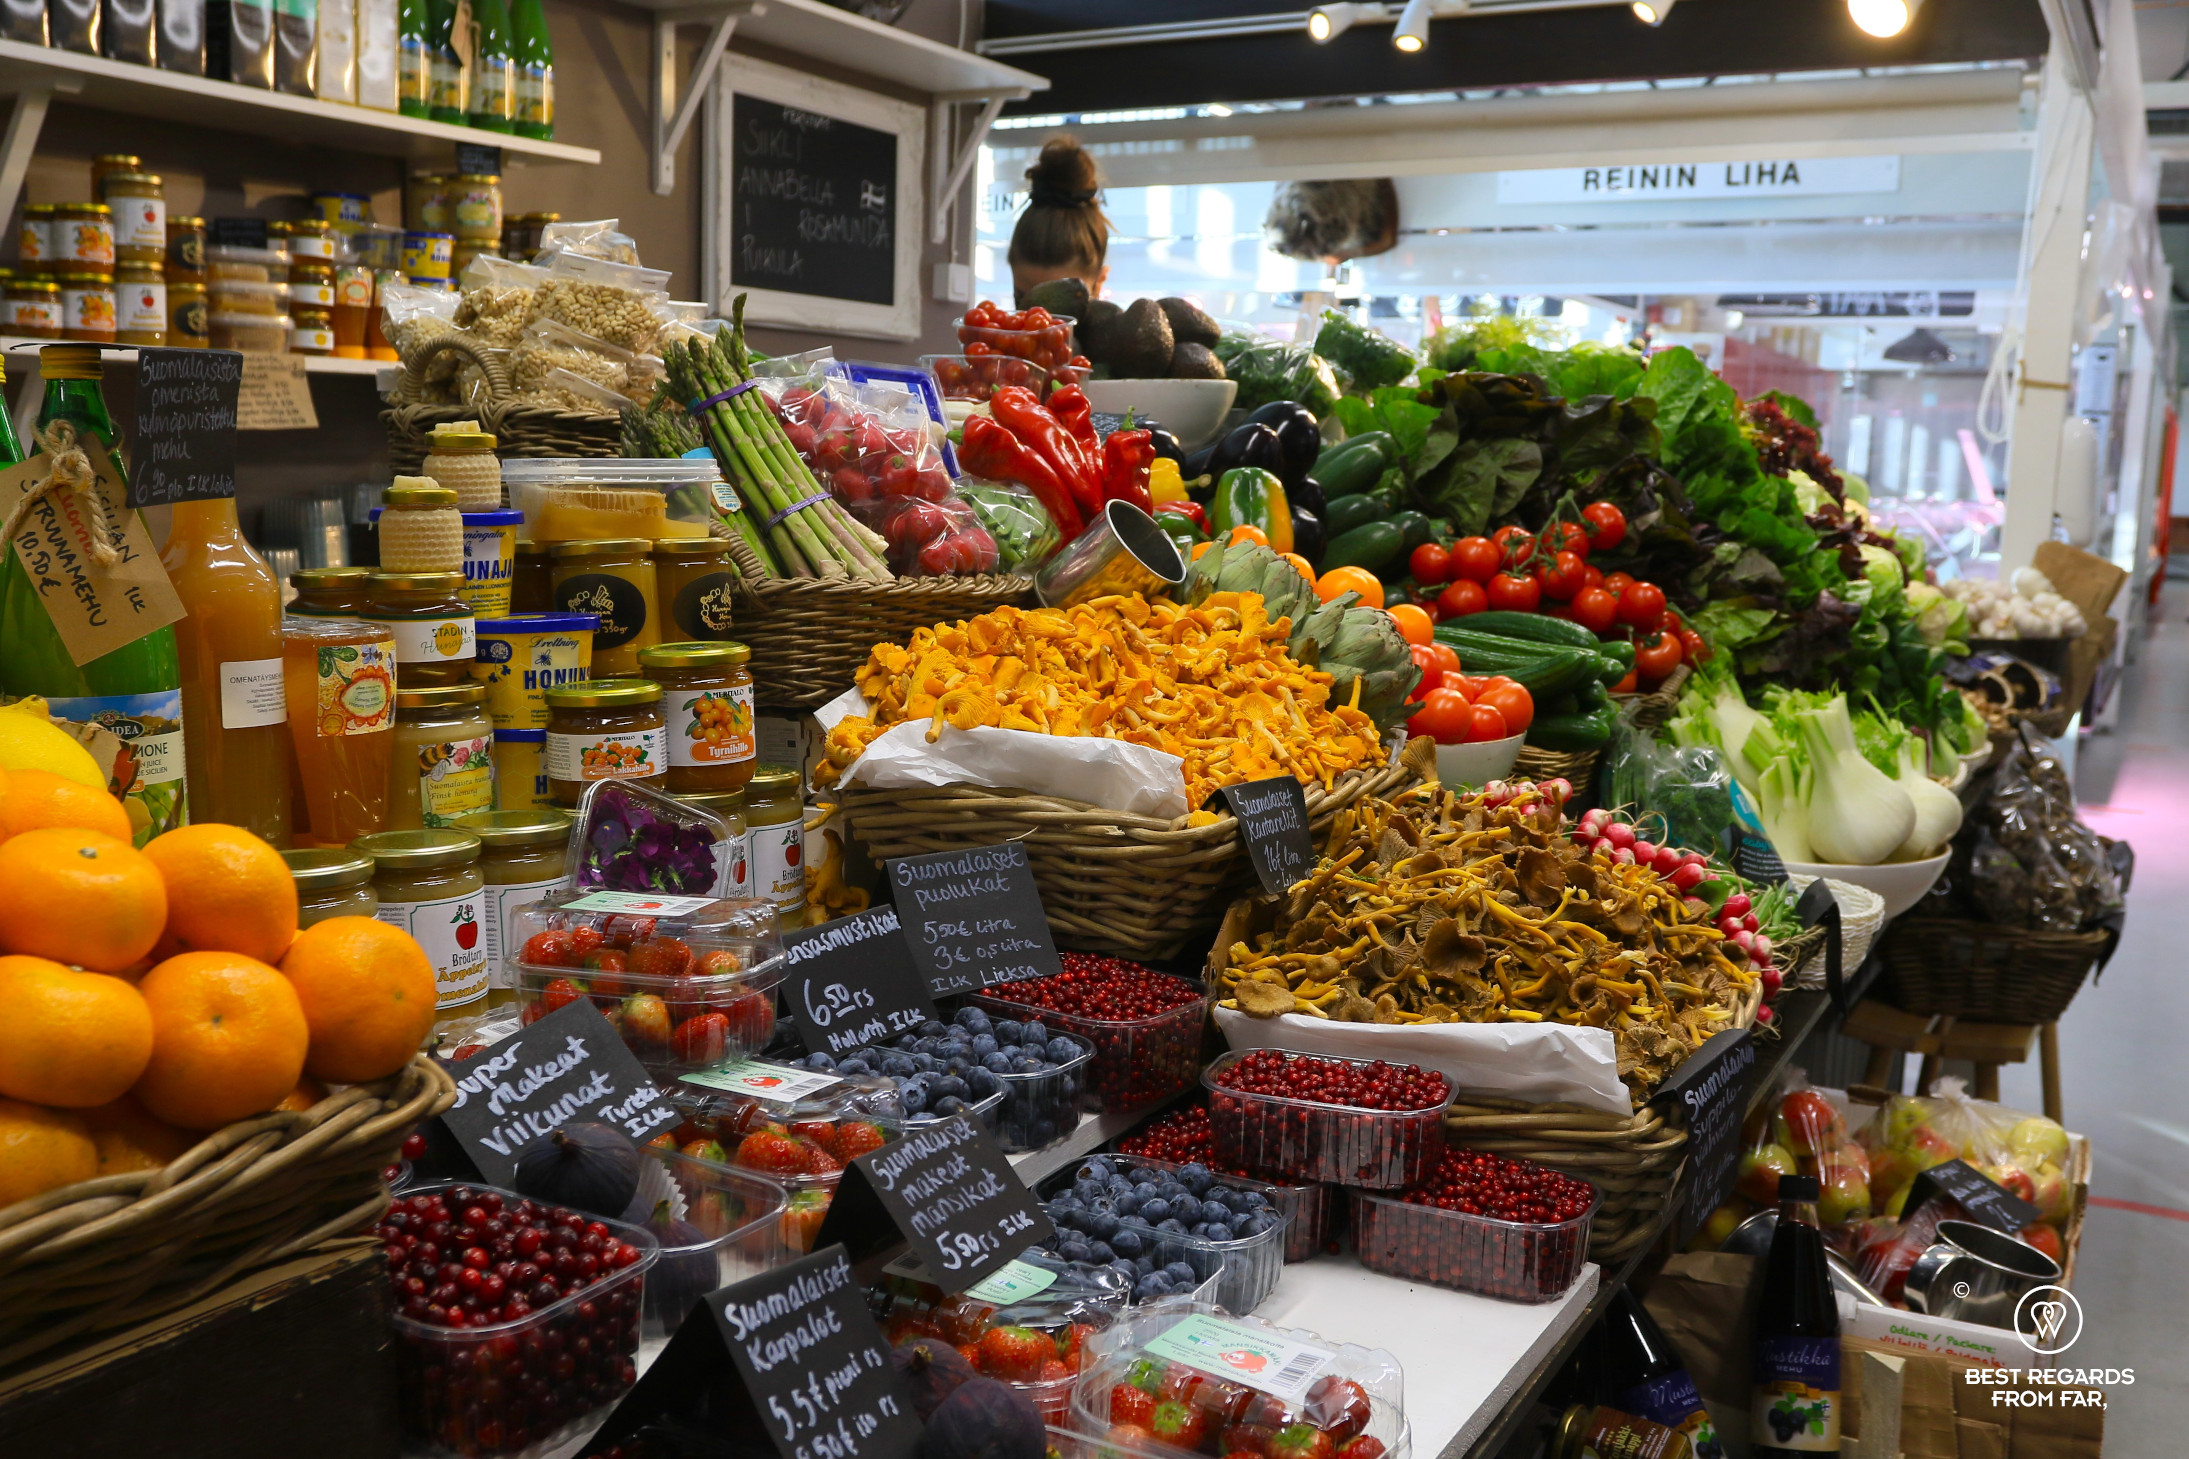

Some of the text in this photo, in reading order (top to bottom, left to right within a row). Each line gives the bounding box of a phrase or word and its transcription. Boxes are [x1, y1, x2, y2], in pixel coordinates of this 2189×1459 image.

[1583, 161, 1801, 191] REININ LIHA
[20, 478, 108, 627] STRUUNAMEHU
[463, 558, 513, 581] UNAJA
[431, 626, 467, 638] STADIN
[134, 742, 168, 758] MONE
[708, 742, 749, 758] Tyrnihillo
[612, 764, 651, 776] Lakkahillo
[430, 791, 452, 801] Finsk
[896, 846, 1025, 888] Suomalaiset
[787, 910, 902, 966] ensasmustikat
[870, 1116, 978, 1191] Suomalaiset
[901, 1151, 972, 1208] makeat
[910, 1167, 1008, 1238] mansikat
[723, 1254, 850, 1342] Suomalaiset
[1761, 1343, 1832, 1367] ustikka
